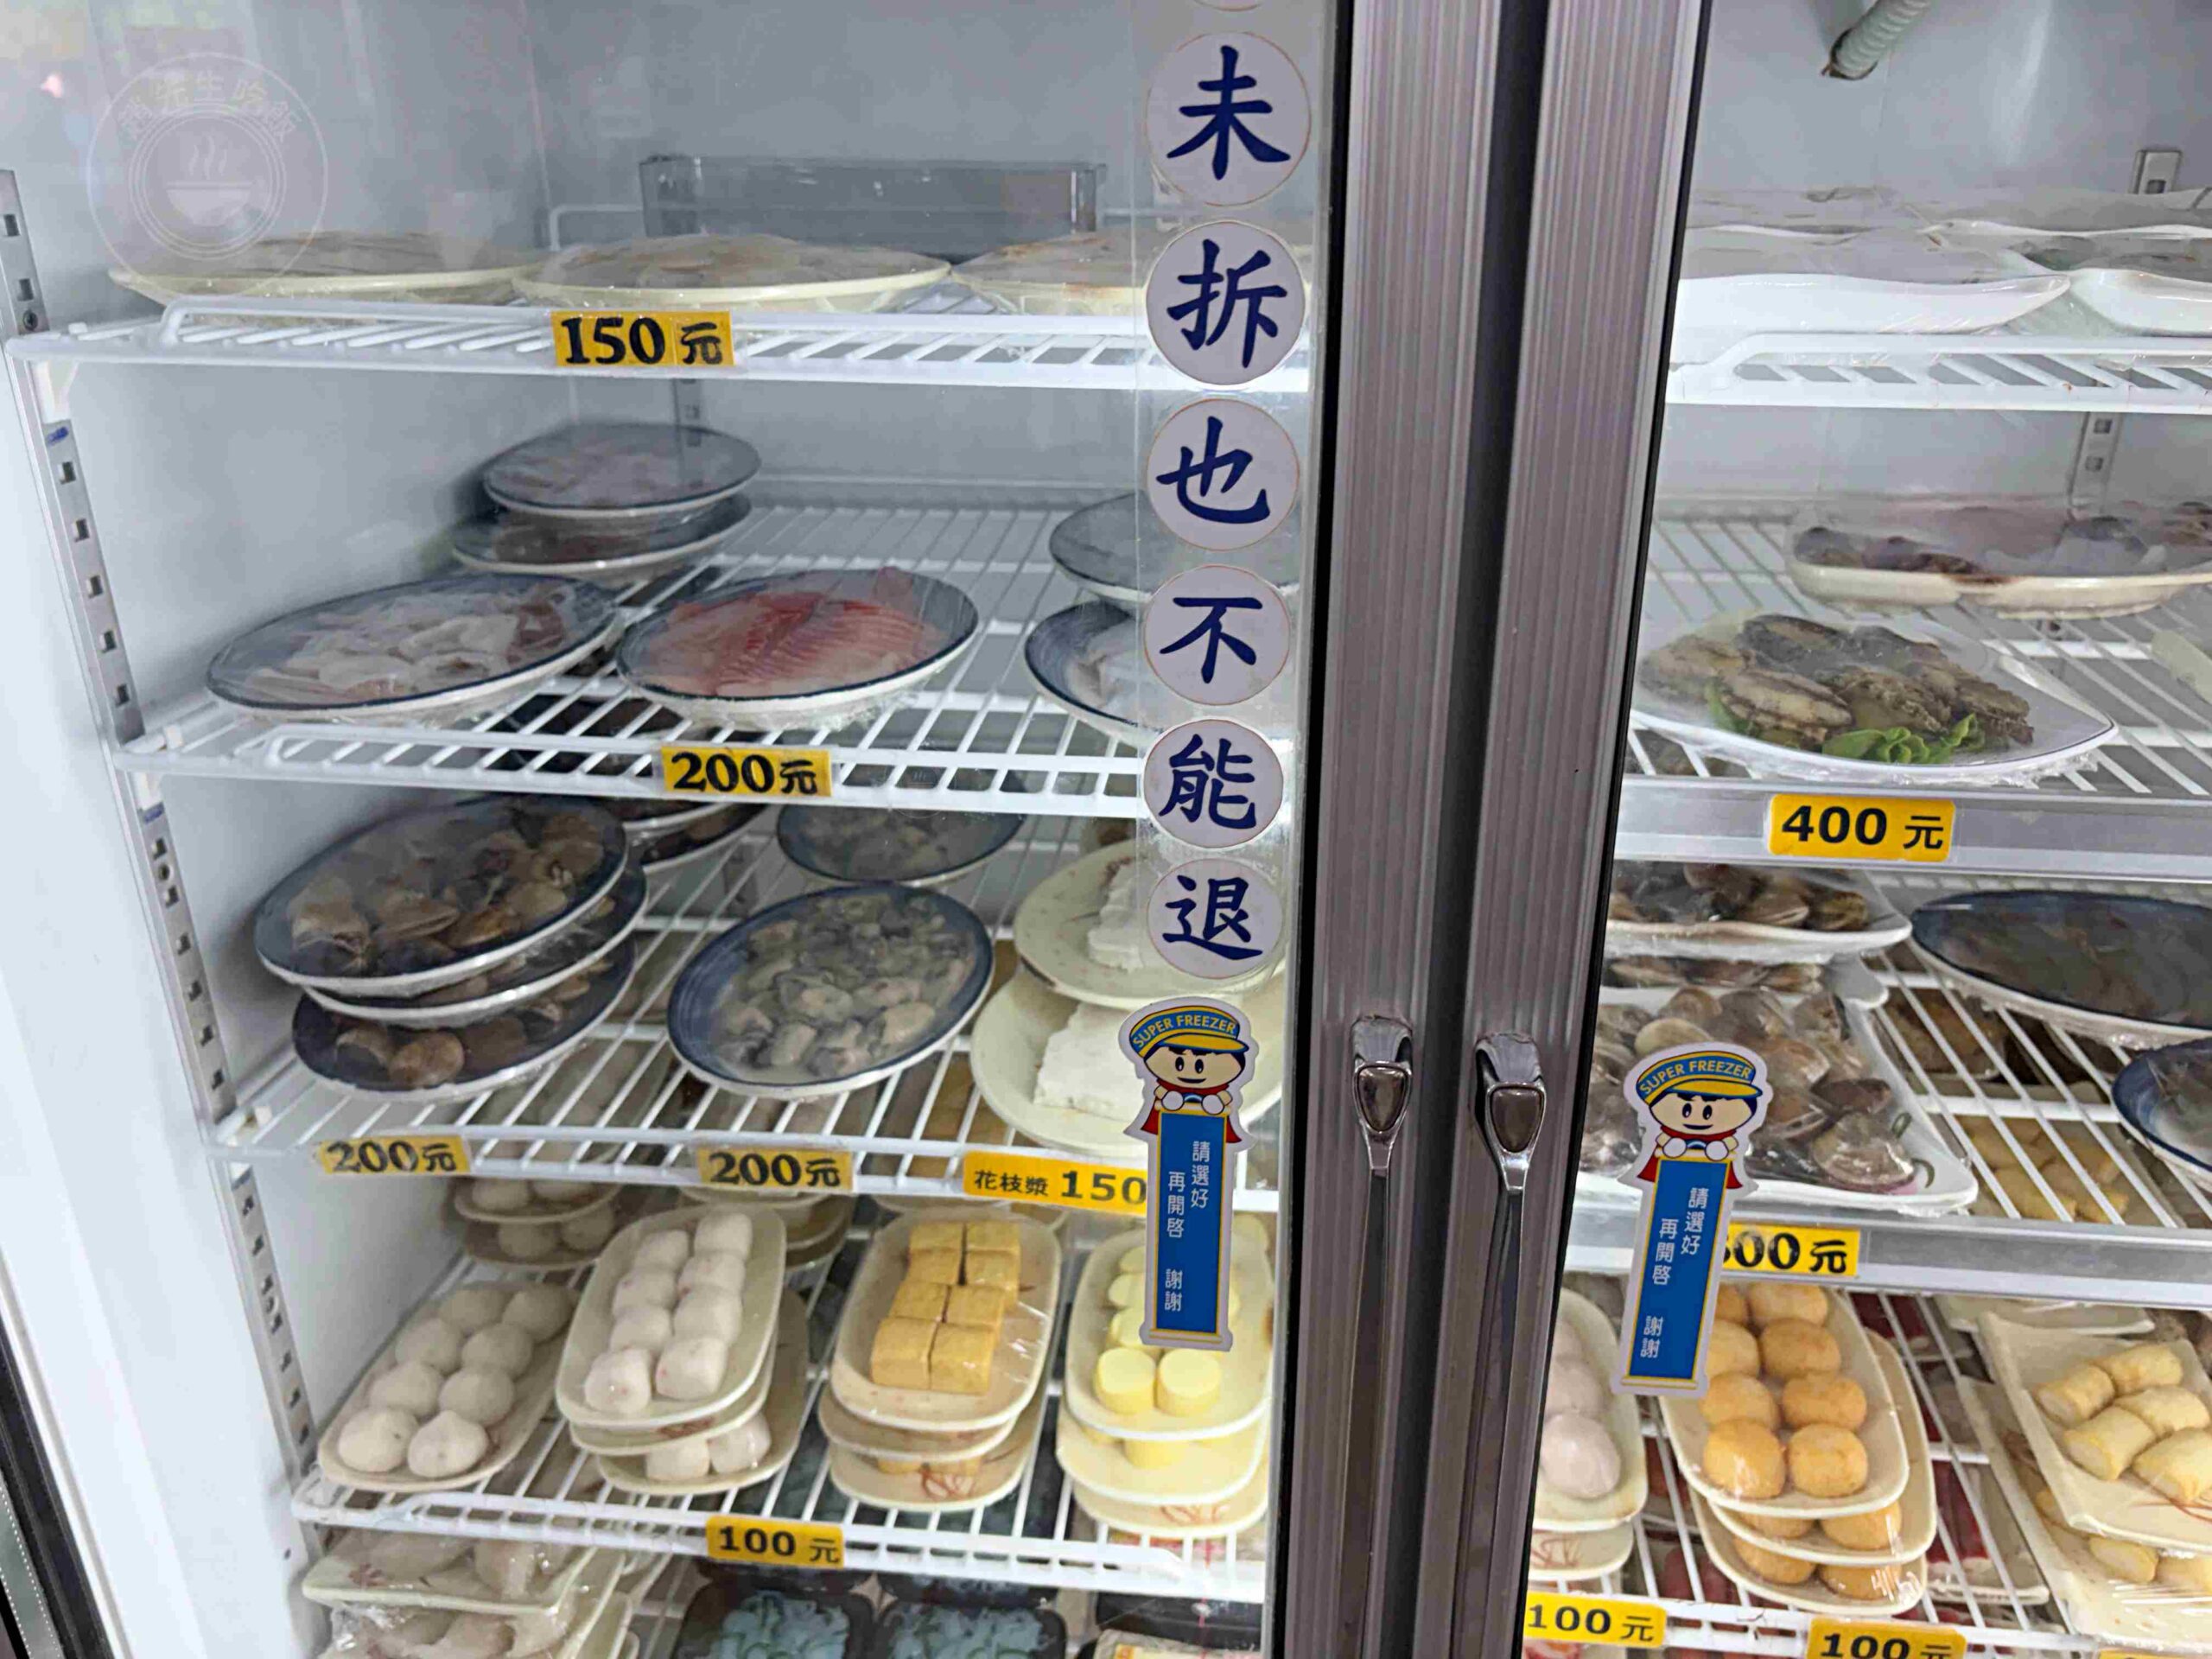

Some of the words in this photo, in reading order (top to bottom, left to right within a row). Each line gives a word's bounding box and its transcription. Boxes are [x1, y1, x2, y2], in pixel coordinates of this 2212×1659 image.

[1156, 45, 1292, 961] 未拆也不能退
[1133, 1018, 1174, 1048] SUPER
[1176, 1014, 1236, 1034] FREEZER
[1639, 1064, 1685, 1095] SUPER
[1688, 1059, 1752, 1079] FREEZER
[1061, 1170, 1147, 1205] 150
[1190, 1141, 1211, 1210] 請選好
[1681, 1187, 1709, 1255] 請選好
[1724, 1230, 1847, 1274] 00元
[1164, 1268, 1183, 1312] 謝謝
[1640, 1315, 1663, 1358] 謝謝
